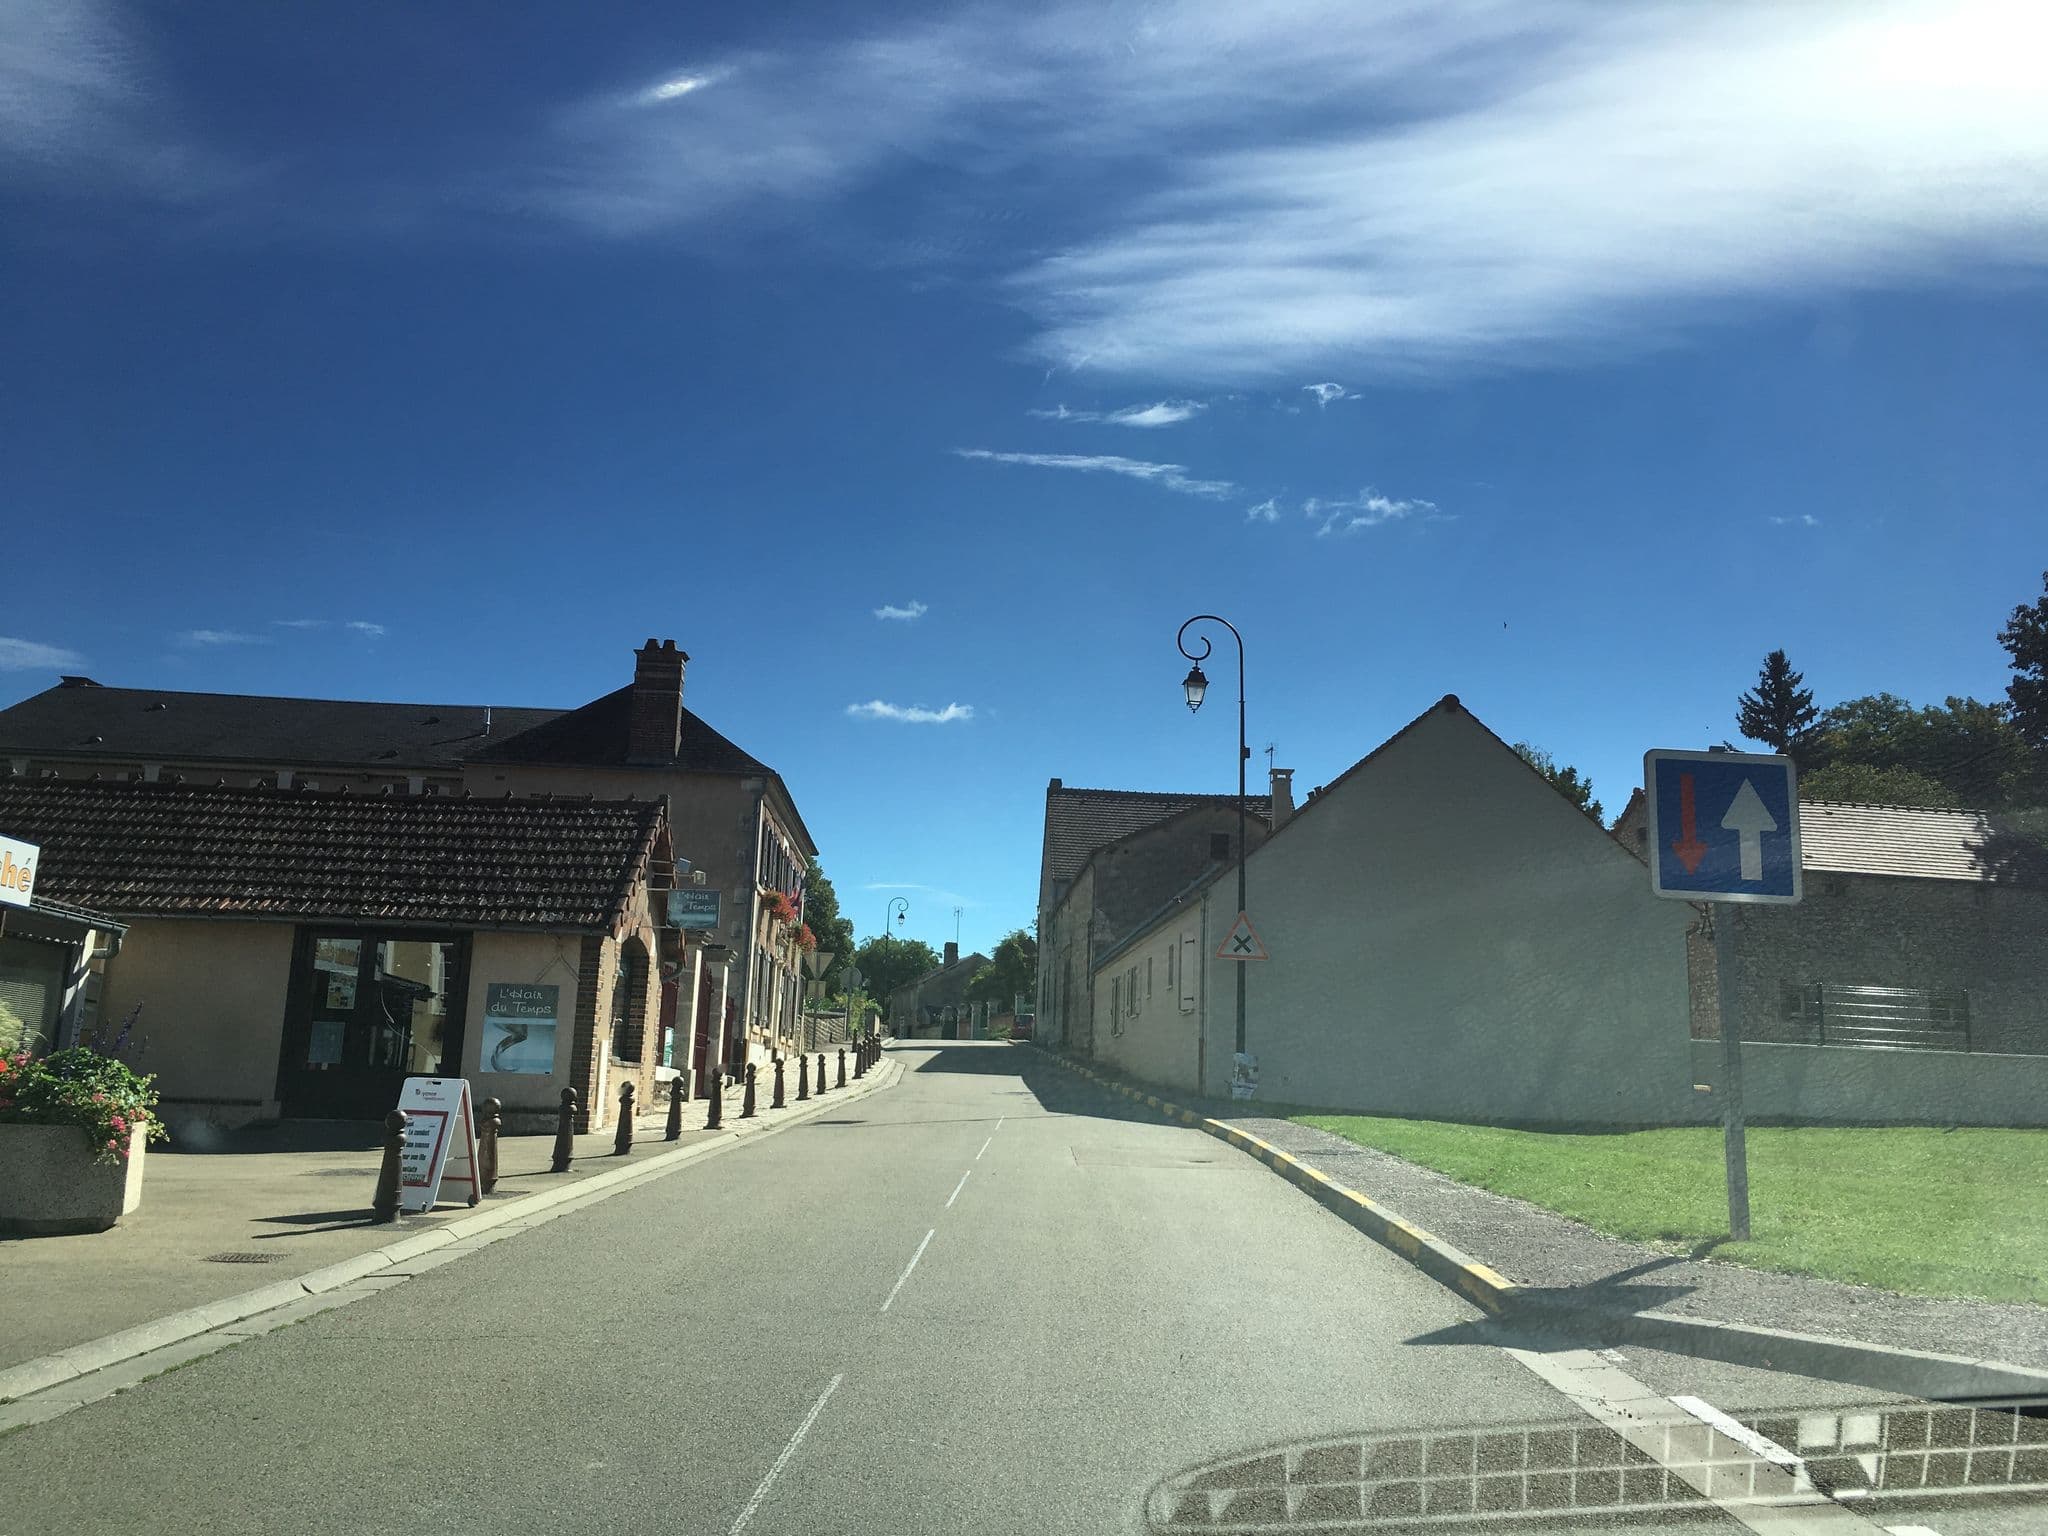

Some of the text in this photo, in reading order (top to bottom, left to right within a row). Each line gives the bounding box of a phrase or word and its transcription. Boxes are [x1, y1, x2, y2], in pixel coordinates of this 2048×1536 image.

[0, 850, 31, 892] hé
[490, 1001, 552, 1016] du Temps
